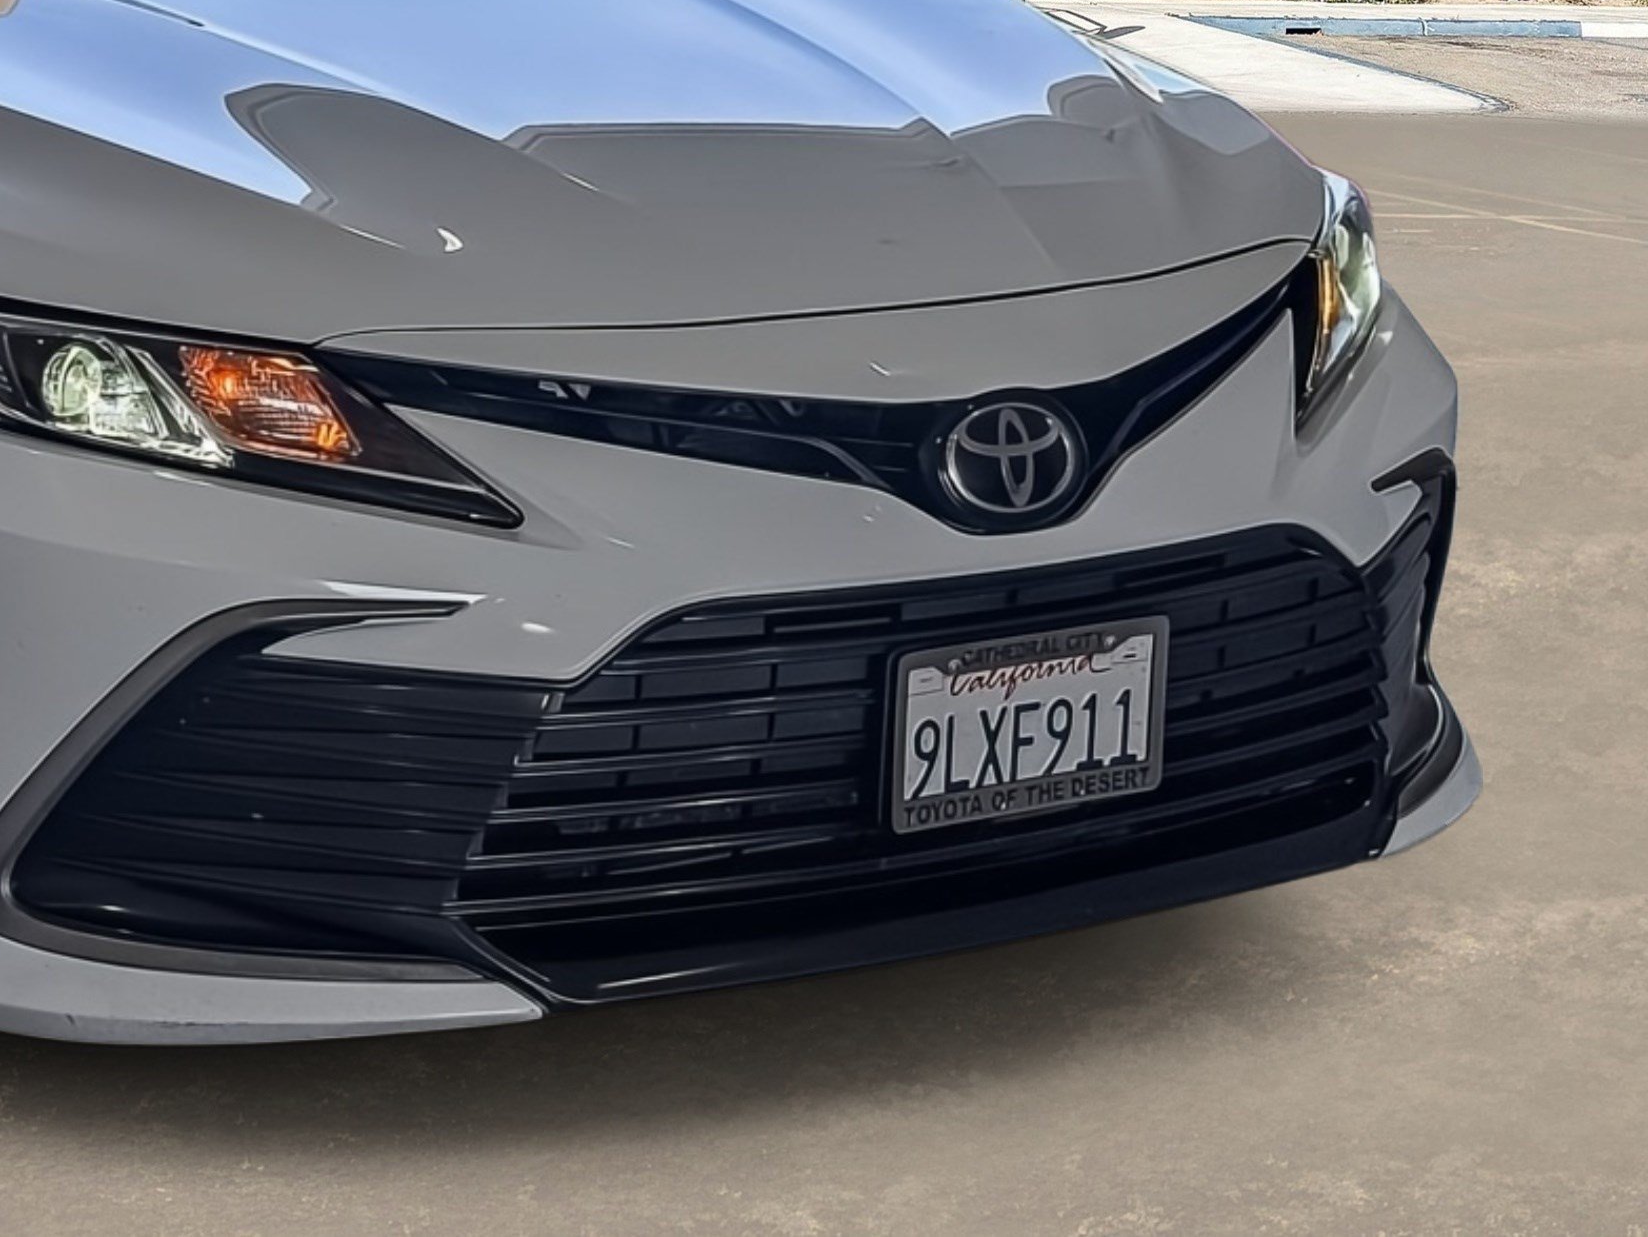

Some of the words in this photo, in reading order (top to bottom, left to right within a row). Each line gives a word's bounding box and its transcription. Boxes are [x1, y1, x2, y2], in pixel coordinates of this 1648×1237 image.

[908, 688, 1137, 800] 9LXF911
[904, 795, 983, 828] TOYOTA
[991, 788, 1018, 812] OF
[1025, 780, 1065, 805] THE
[1071, 766, 1150, 798] DESERT
